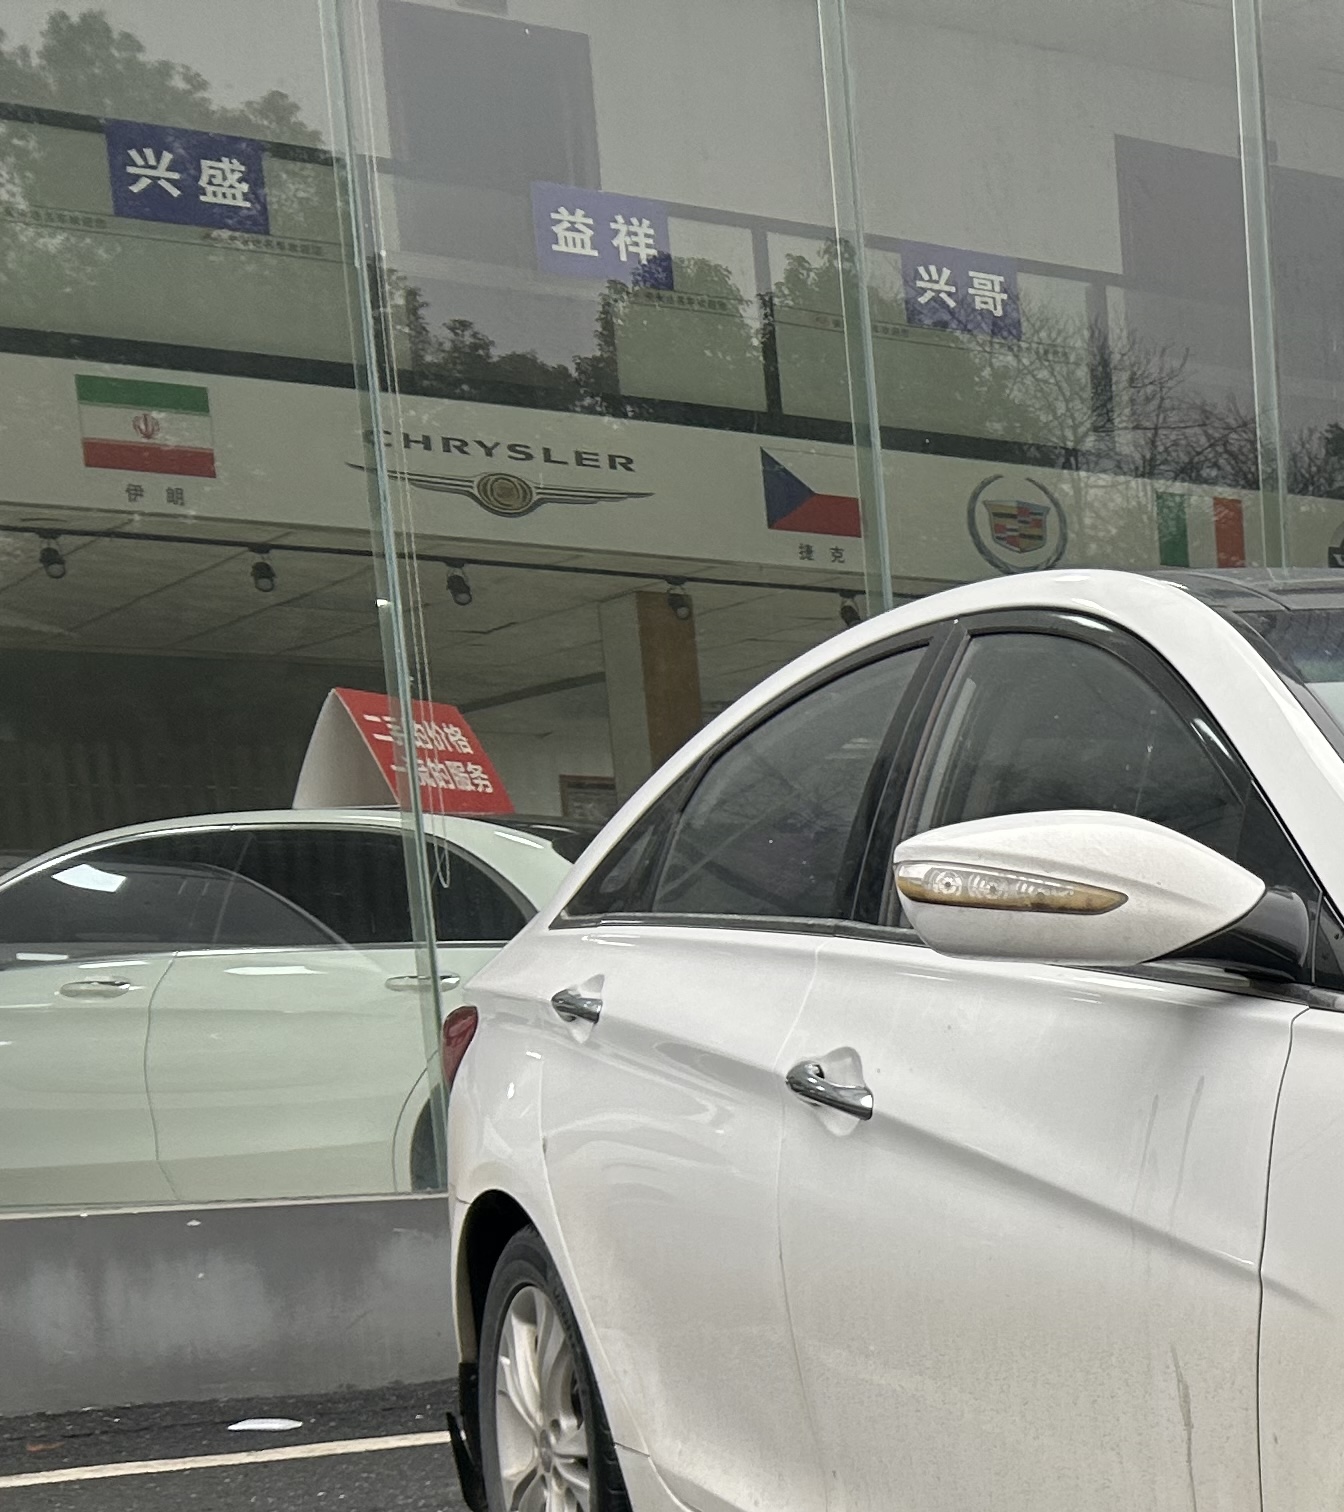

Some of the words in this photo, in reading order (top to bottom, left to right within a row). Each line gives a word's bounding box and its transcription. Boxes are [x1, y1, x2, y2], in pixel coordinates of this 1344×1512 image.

[125, 146, 253, 209] 兴盛
[550, 206, 659, 267] 益祥
[916, 264, 1008, 317] 兴哥
[364, 429, 638, 474] CHRYSLER
[126, 482, 187, 508] 伊朗
[797, 542, 846, 564] 捷克
